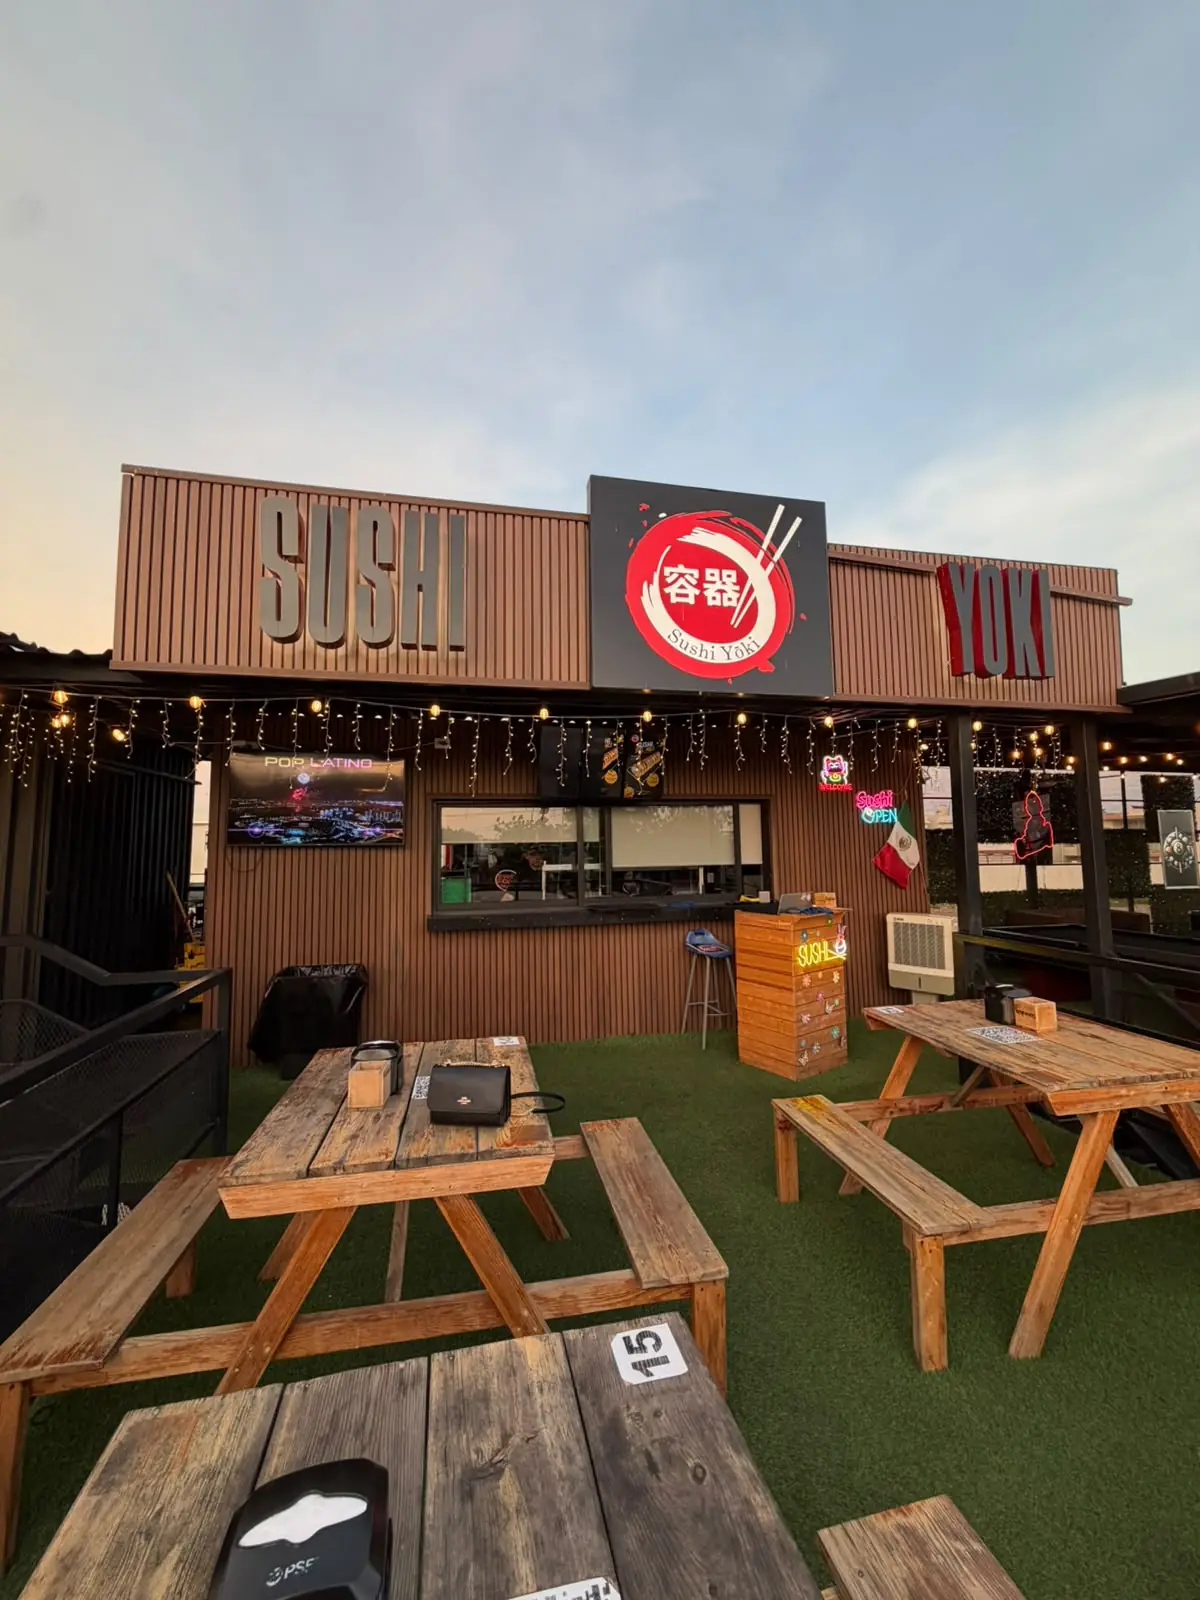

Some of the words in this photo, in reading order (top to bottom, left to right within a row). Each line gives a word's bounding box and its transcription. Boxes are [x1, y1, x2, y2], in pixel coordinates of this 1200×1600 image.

[260, 496, 465, 652] SUSHI
[663, 564, 740, 607] 容器
[936, 562, 1055, 680] YOKI
[667, 628, 716, 661] Sushi
[264, 756, 305, 768] POP
[310, 757, 373, 769] LATINO
[861, 807, 898, 824] OPEN
[797, 940, 829, 967] SUSHI
[622, 1330, 670, 1378] 15
